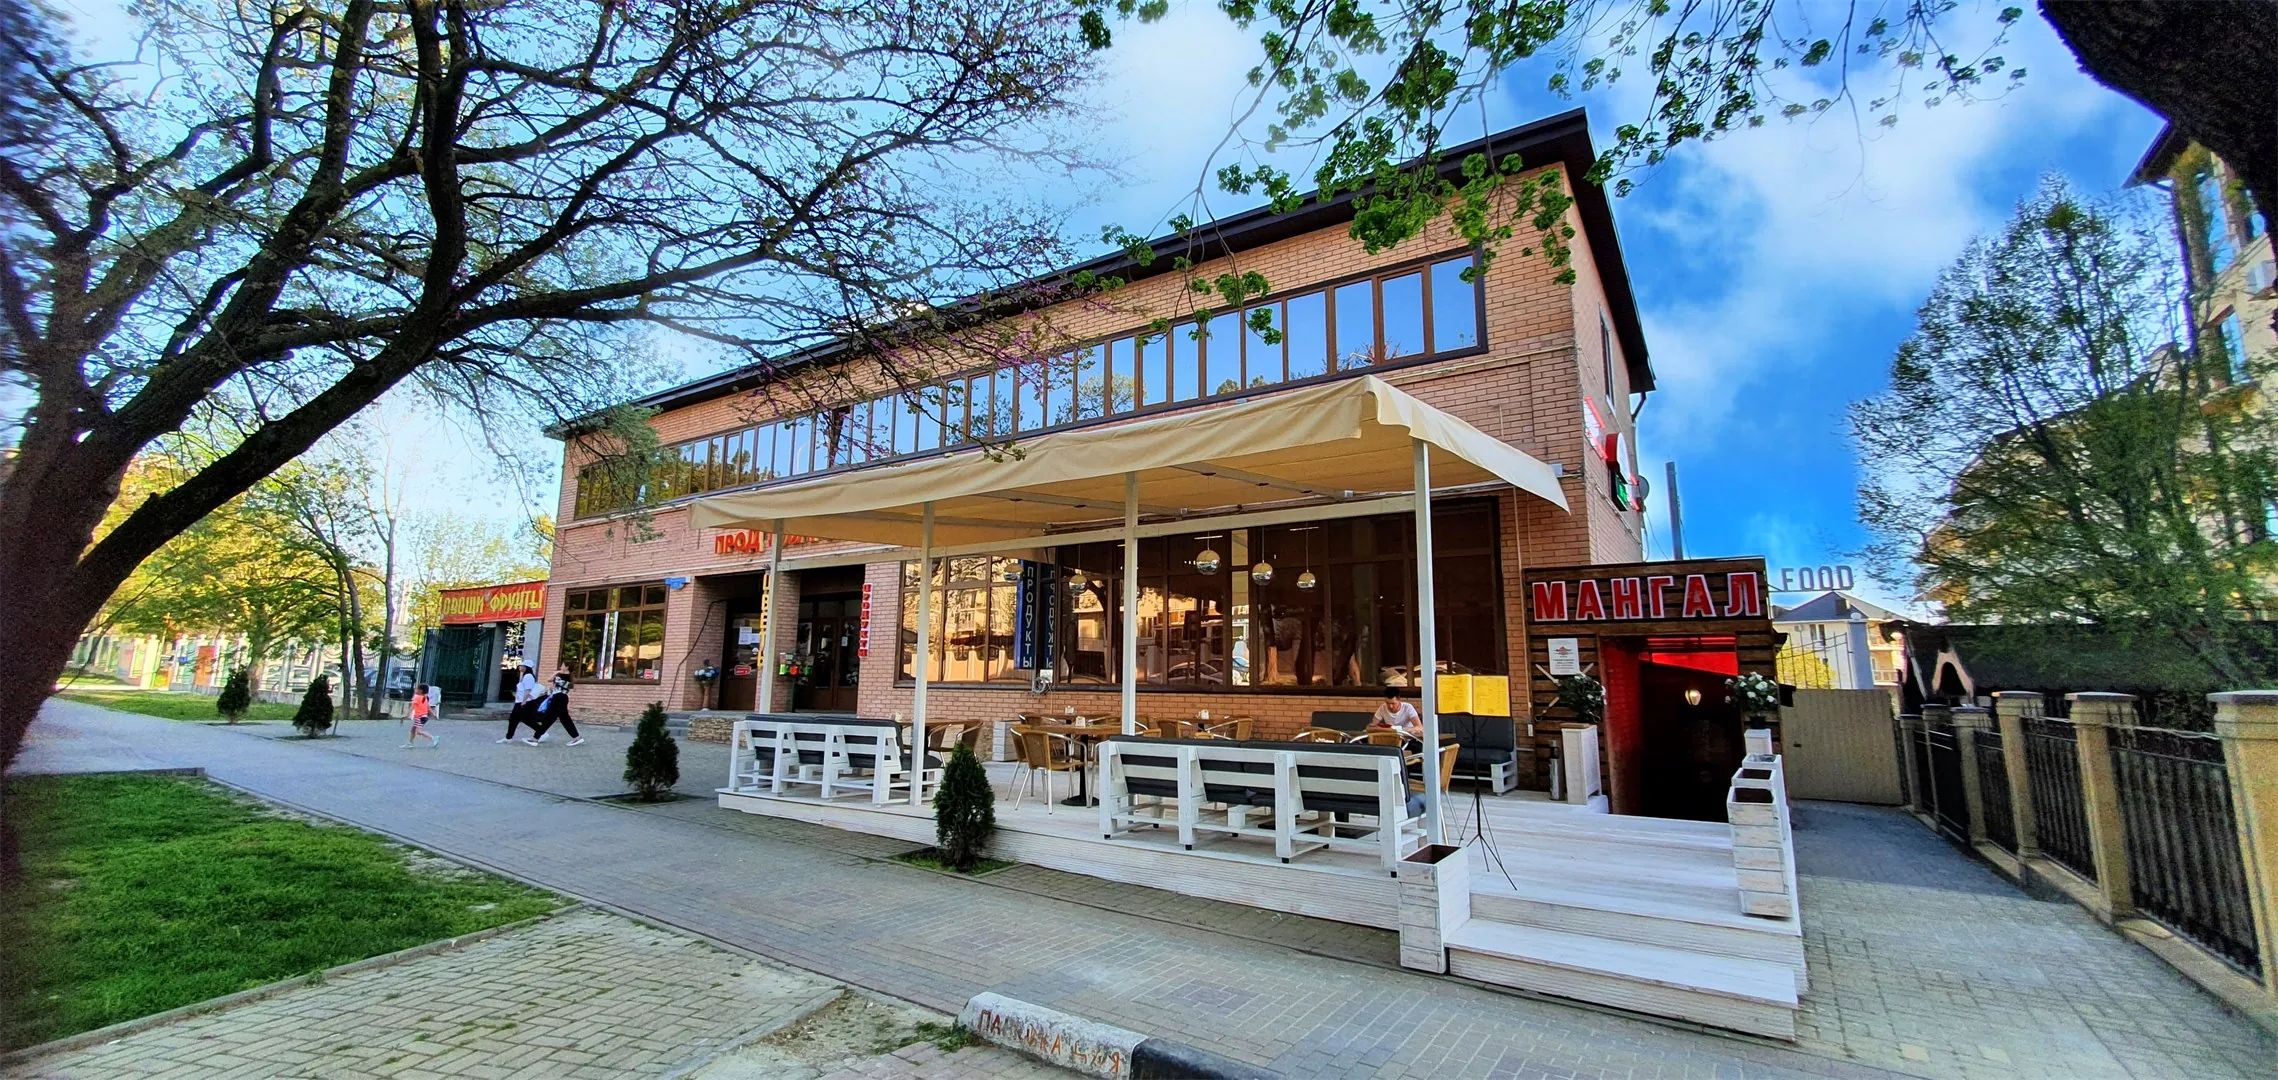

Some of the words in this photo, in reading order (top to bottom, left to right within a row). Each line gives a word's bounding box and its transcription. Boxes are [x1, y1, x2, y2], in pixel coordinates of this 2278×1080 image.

[1532, 572, 1761, 622] МАНГАЛ
[1781, 565, 1854, 591] FOOD
[858, 584, 872, 657] ПРОДУКТЫ
[1022, 566, 1034, 668] ПРОДУКТЫ
